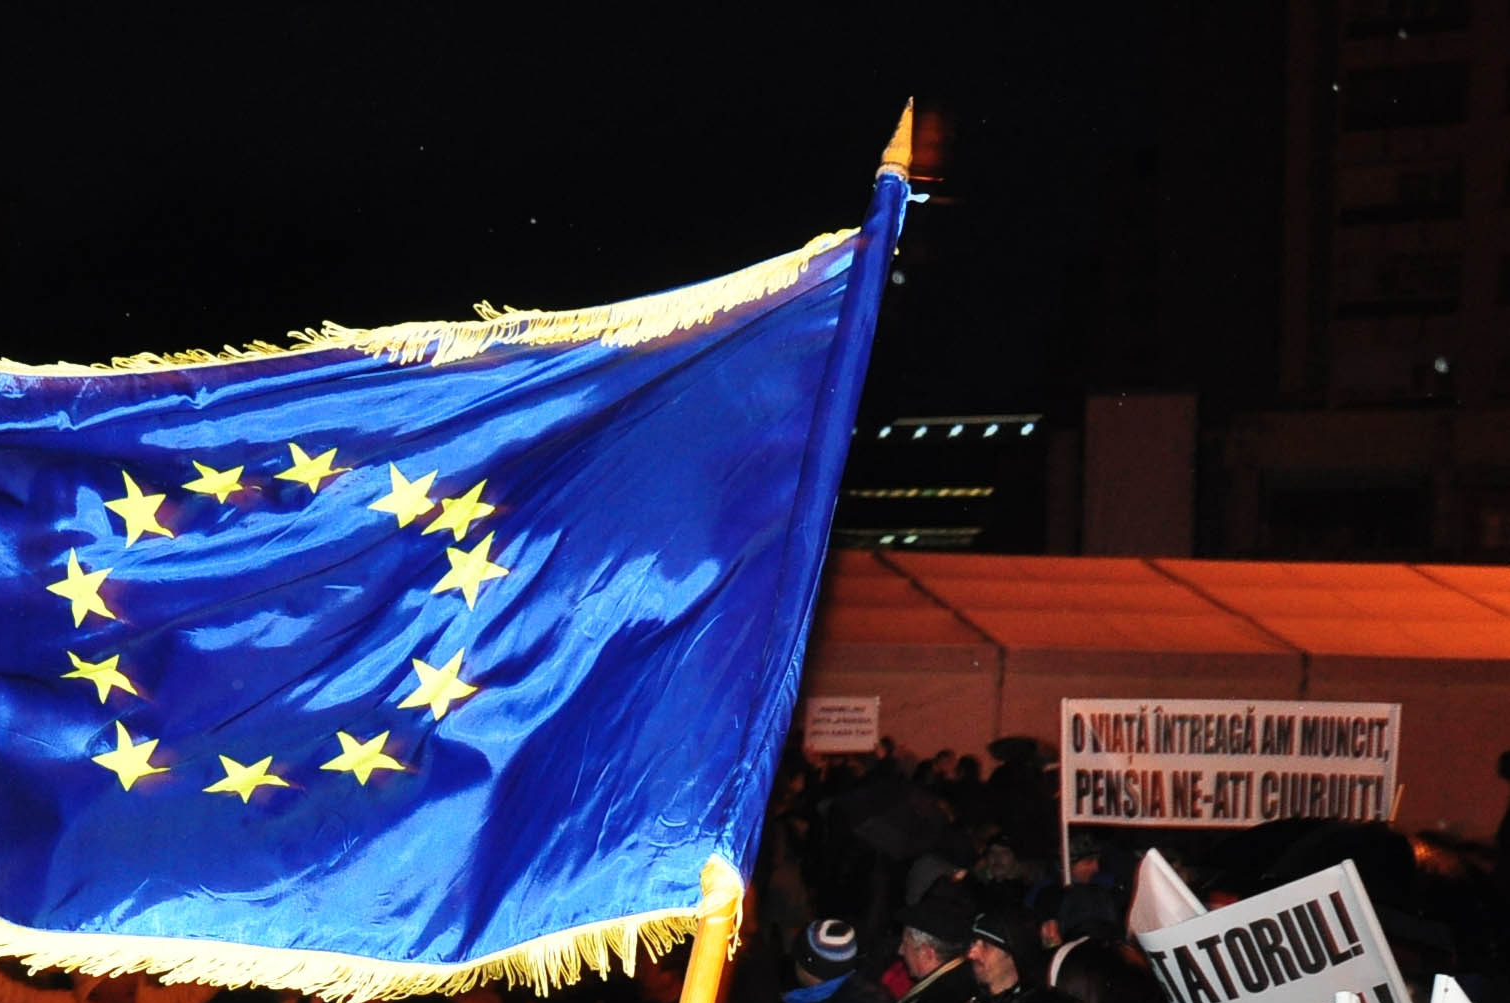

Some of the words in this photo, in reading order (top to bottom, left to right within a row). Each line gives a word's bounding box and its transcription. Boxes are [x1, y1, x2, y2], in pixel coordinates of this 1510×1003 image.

[1072, 712, 1086, 754] O
[1154, 705, 1257, 756] ÎNTREAGĂ
[1261, 714, 1296, 757] AM
[1300, 715, 1390, 765] MUNCIT,
[1075, 768, 1167, 819] PENSIA
[1173, 770, 1254, 821] NE-ATI
[1261, 770, 1385, 821] CIURUIT!
